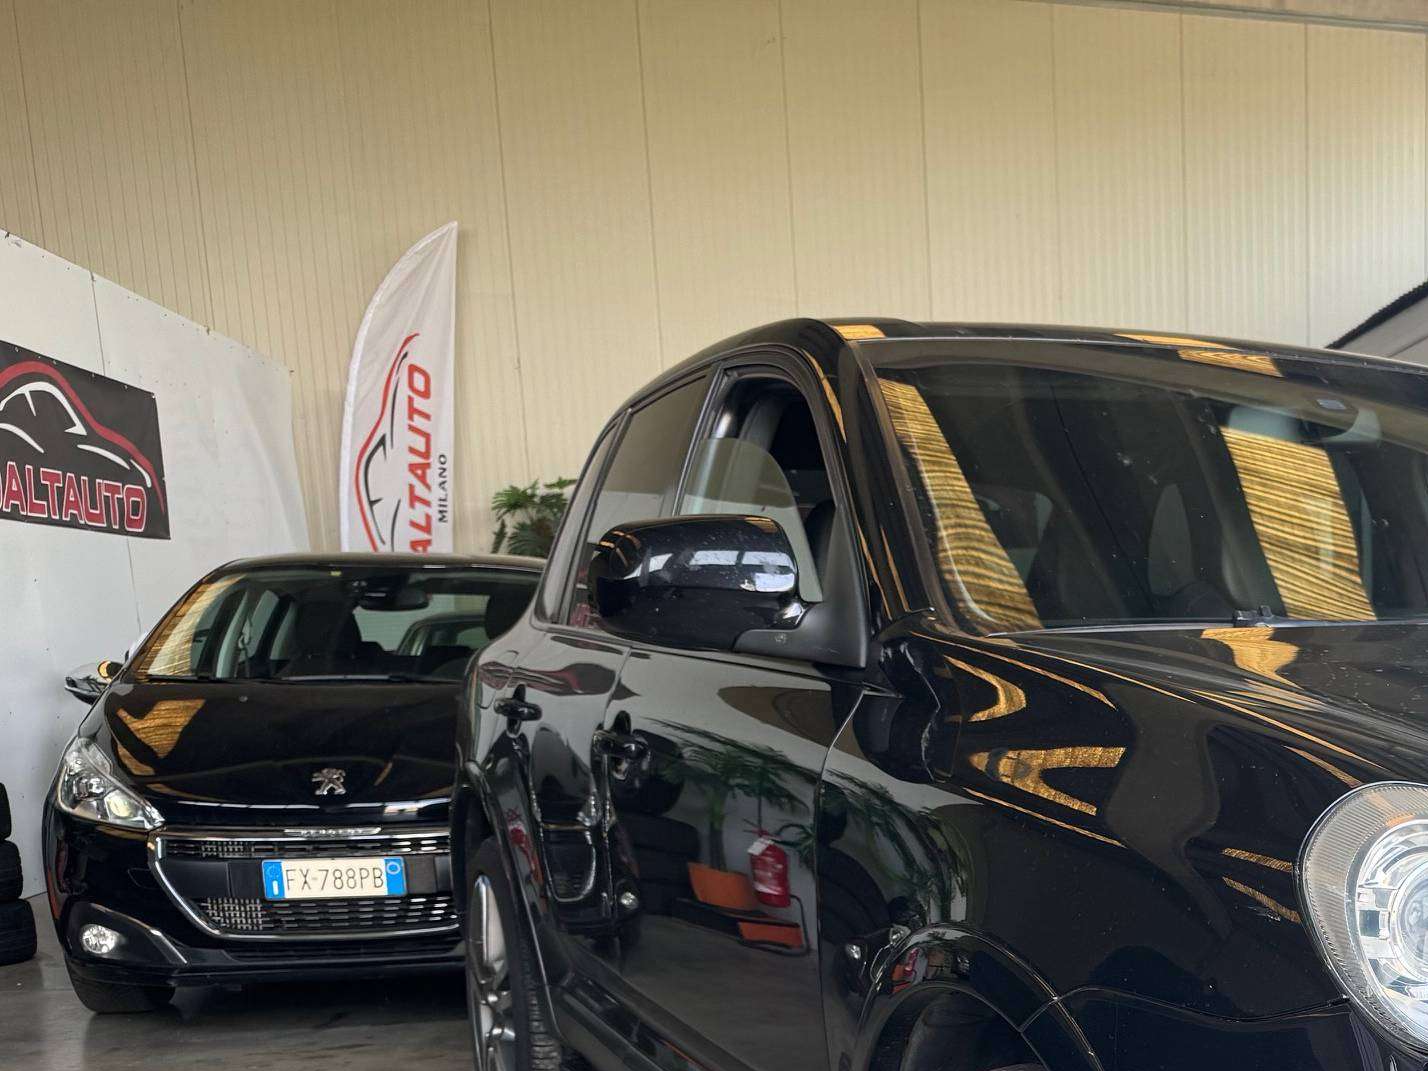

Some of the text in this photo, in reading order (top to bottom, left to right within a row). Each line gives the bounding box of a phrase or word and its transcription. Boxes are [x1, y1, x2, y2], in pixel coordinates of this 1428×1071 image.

[408, 363, 432, 556] ALTAUTO
[438, 454, 448, 523] MILANO
[0, 461, 147, 532] ALTAUTO
